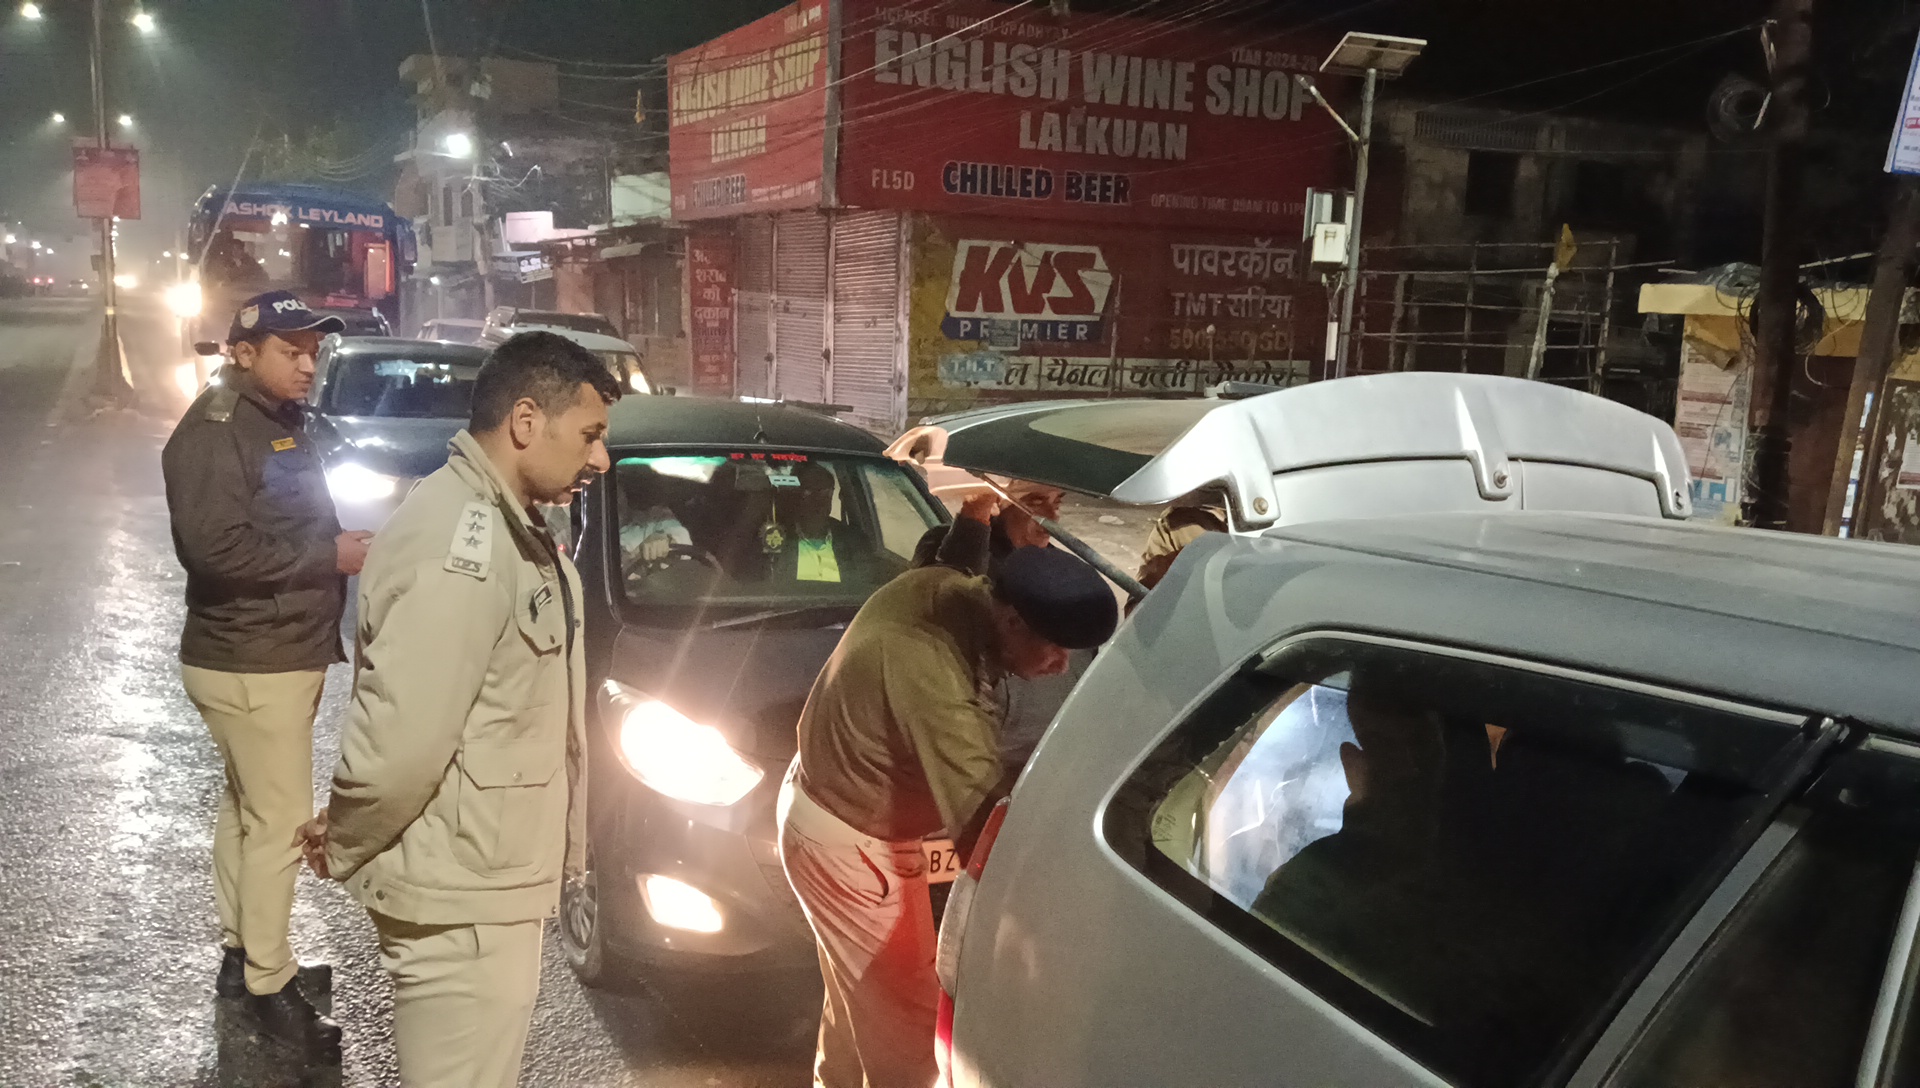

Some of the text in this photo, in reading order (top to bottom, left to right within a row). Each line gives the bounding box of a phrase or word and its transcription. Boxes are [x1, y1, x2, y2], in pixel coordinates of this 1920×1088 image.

[875, 29, 1316, 122] ENGLISH WINE SHOP
[1019, 109, 1188, 160] LALKUAN
[871, 168, 915, 190] FL5D
[942, 160, 1132, 205] CHILLED BEER
[224, 201, 384, 228] ASHOK LEYLAND
[1170, 237, 1298, 279] पावरकॉन
[955, 245, 1097, 315] KVS
[1171, 292, 1224, 316] TMT
[960, 320, 1088, 341] PRMIER
[929, 848, 957, 873] BZ
